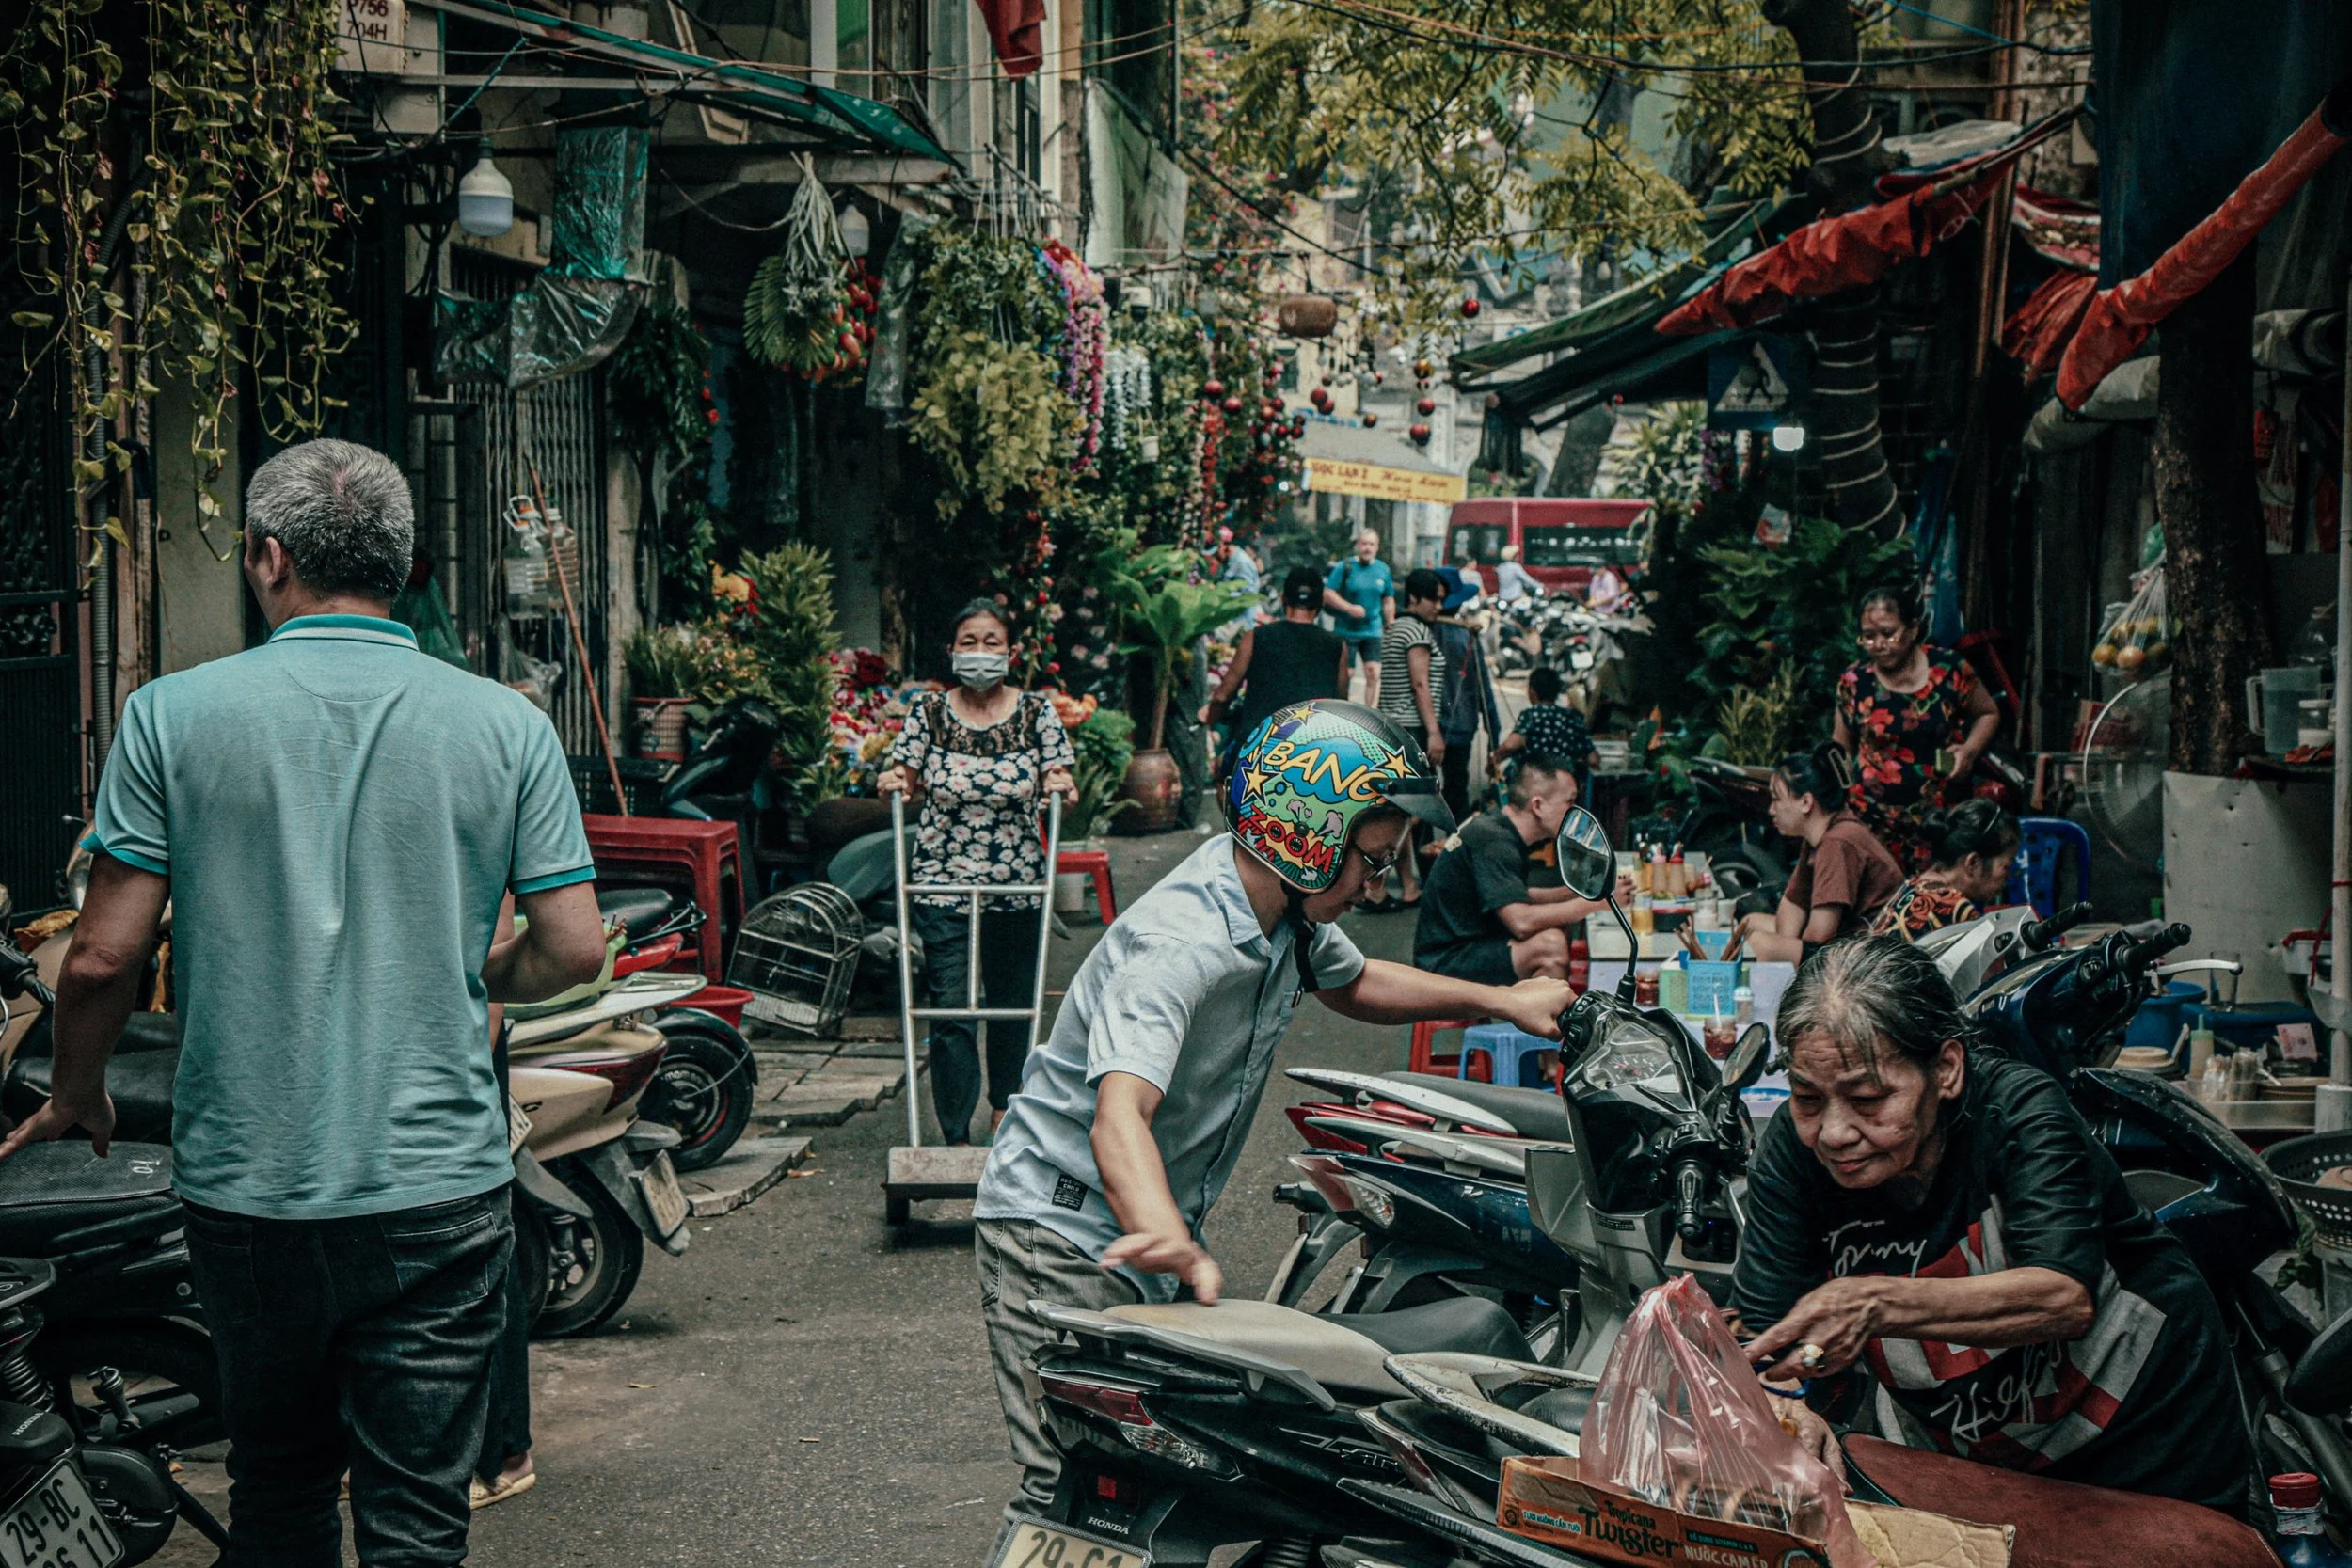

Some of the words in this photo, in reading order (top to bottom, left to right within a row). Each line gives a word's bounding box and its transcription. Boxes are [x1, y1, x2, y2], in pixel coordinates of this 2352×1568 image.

[347, 20, 387, 40] 704H
[1249, 804, 1336, 874] ZOOM
[11, 1411, 45, 1436] HONDA
[6, 1479, 80, 1566] 29-BC
[1087, 1516, 1130, 1535] HONDA
[1604, 1499, 1657, 1530] Tropicana
[1578, 1506, 1682, 1557] Twister
[1018, 1530, 1123, 1568] 29-
[1721, 1552, 1750, 1568] CAM
